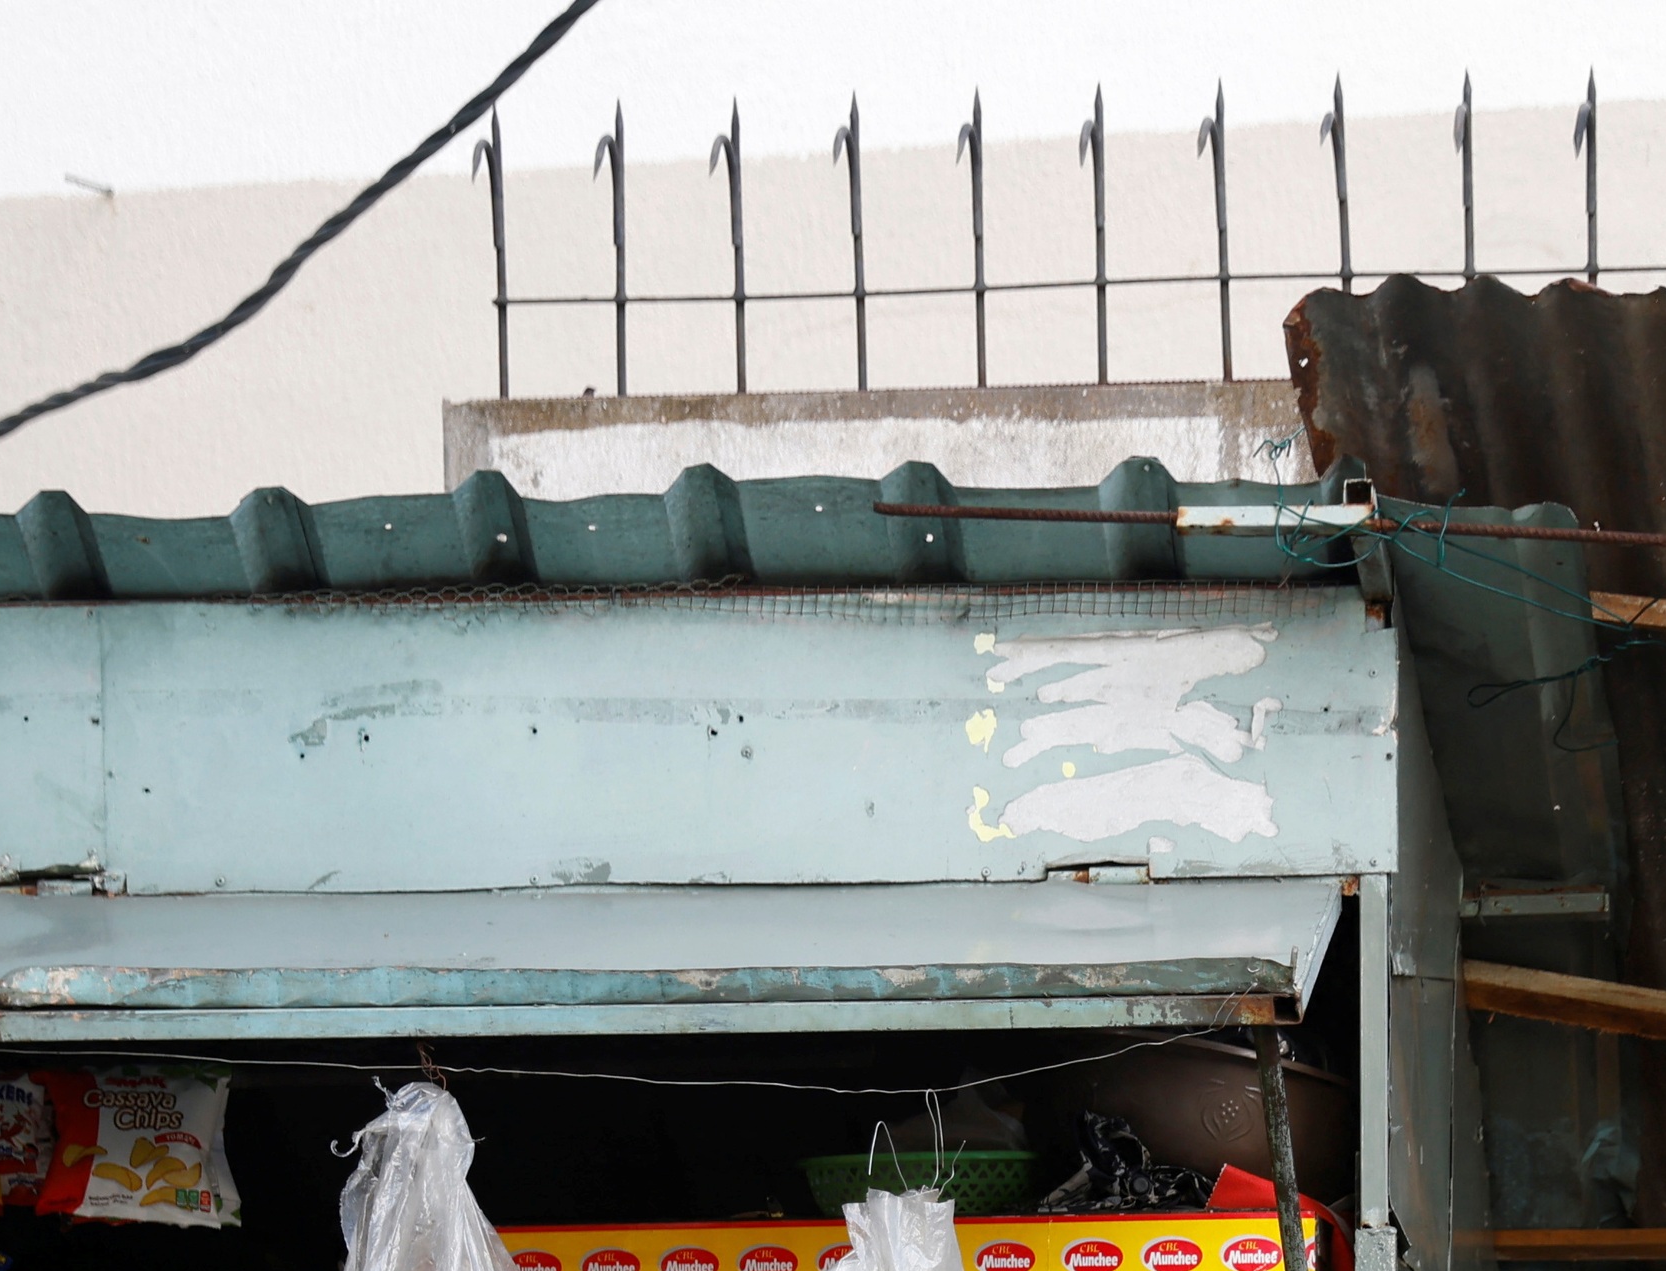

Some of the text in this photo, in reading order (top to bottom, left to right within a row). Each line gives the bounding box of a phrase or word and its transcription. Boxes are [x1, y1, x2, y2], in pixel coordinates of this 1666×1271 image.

[106, 1074, 167, 1089] SMAK
[83, 1089, 176, 1110] Cassava
[114, 1107, 183, 1131] Chips
[983, 1252, 1031, 1269] Munchee
[1069, 1250, 1119, 1268] Munchee
[1150, 1249, 1198, 1266] Munchee
[1229, 1248, 1277, 1265] Munchee
